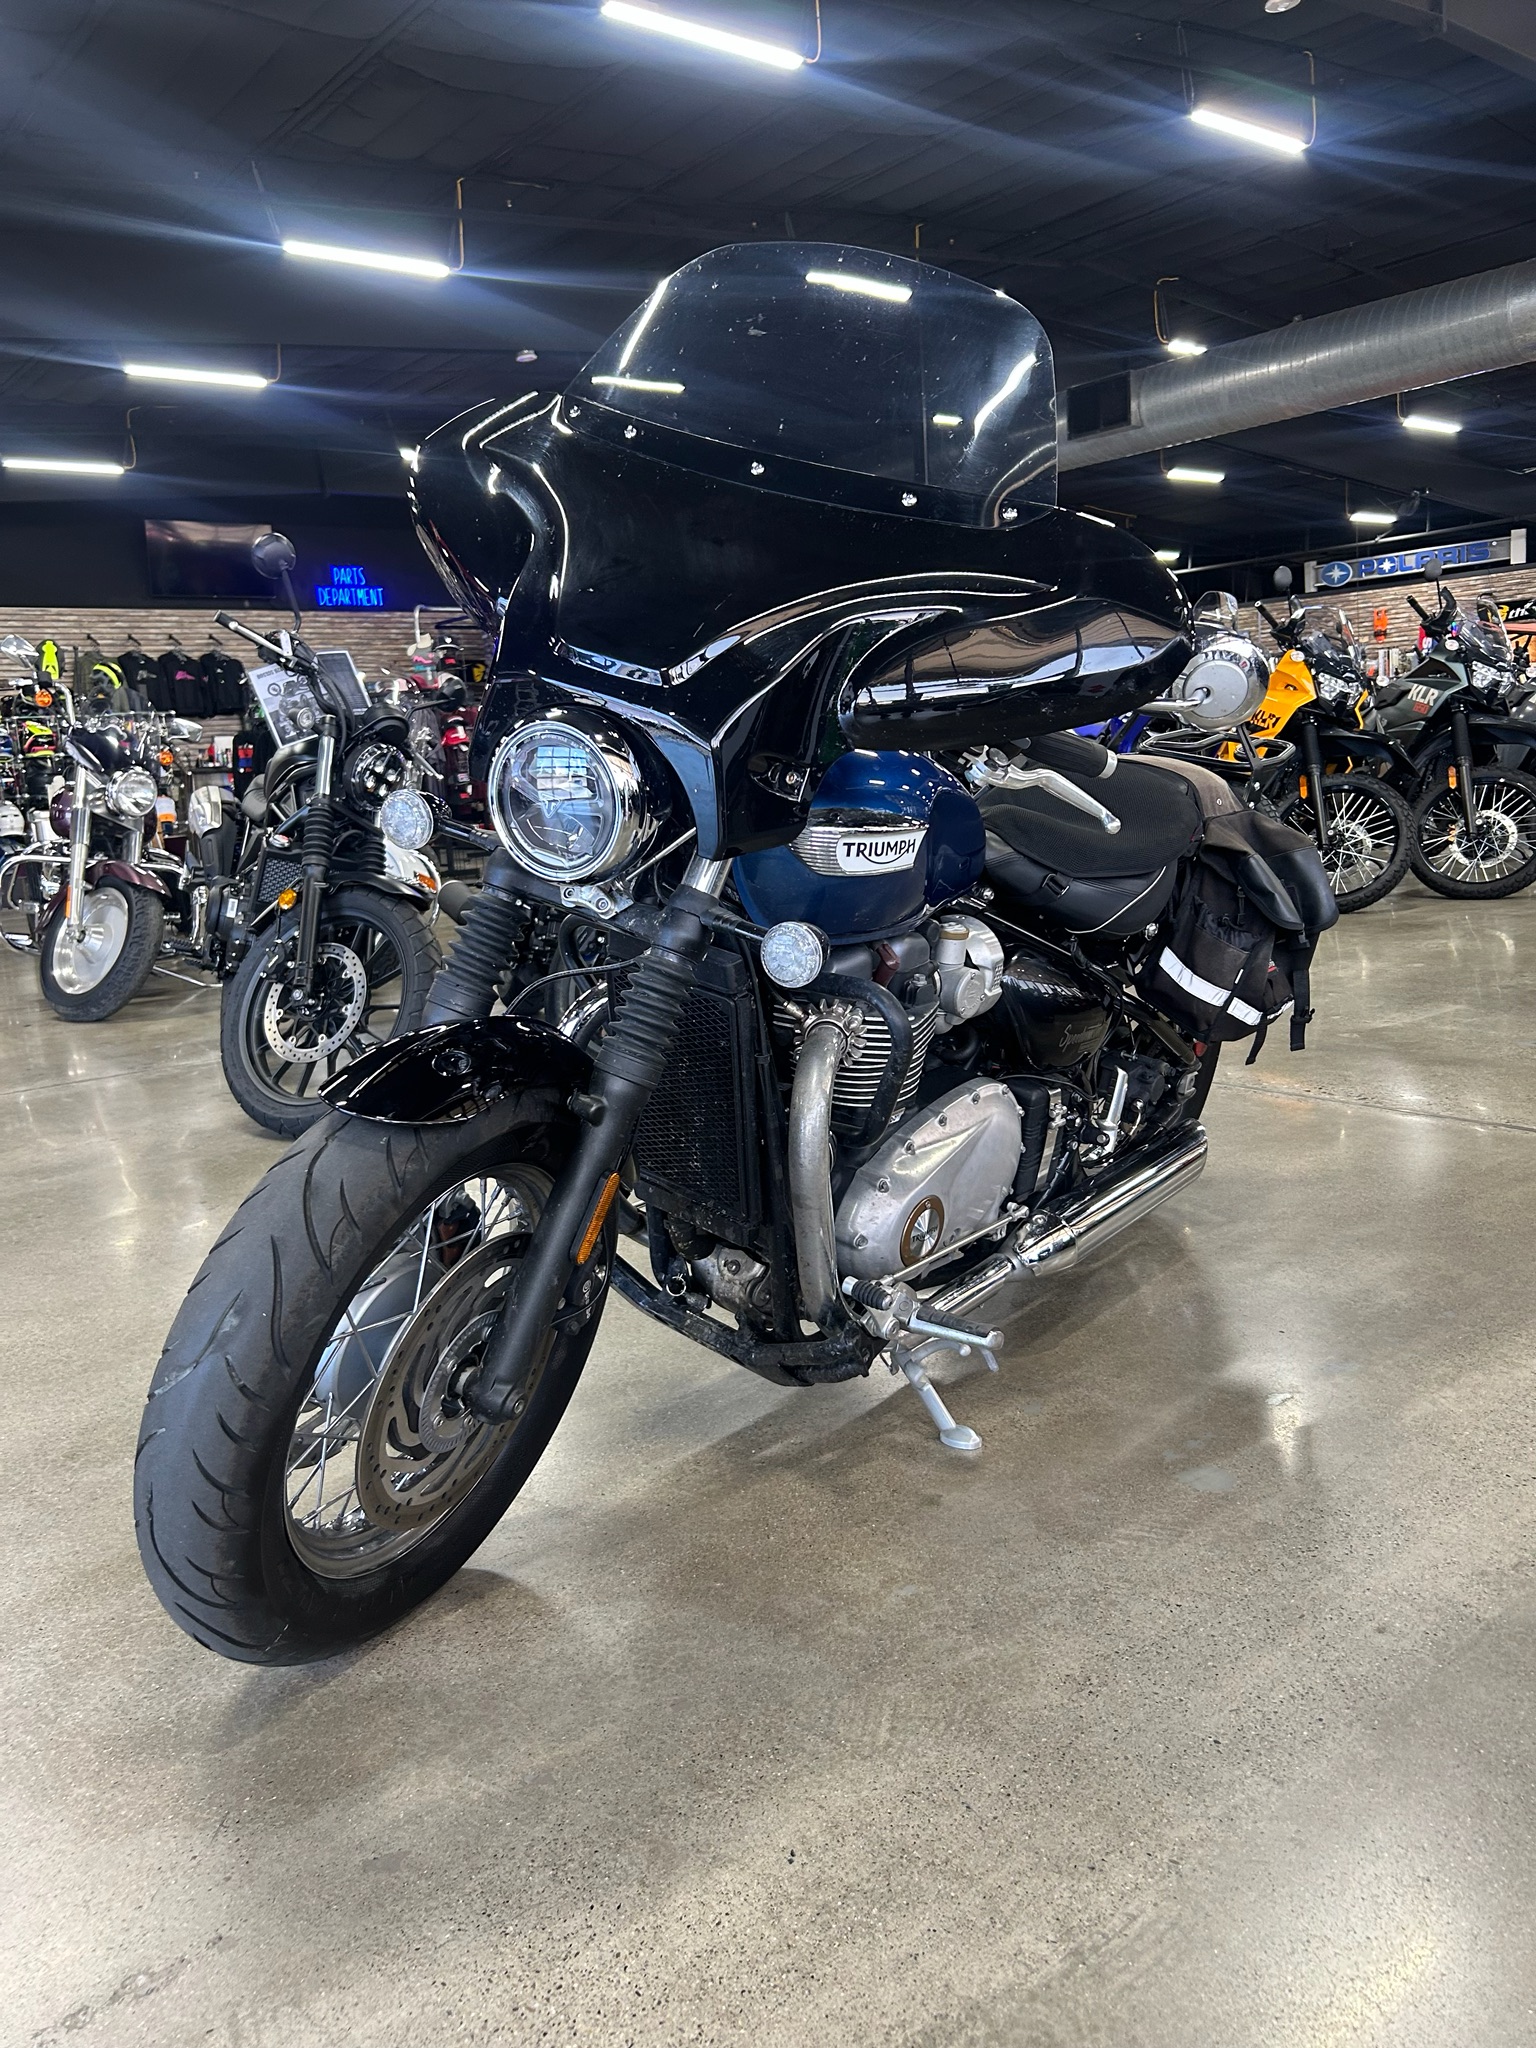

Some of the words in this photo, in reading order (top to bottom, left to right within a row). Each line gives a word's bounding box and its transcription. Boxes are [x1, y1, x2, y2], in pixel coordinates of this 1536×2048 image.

[1358, 541, 1490, 578] POLARIS
[333, 567, 366, 585] PARTS
[318, 587, 384, 606] DEPARTMENT
[1407, 683, 1439, 706] KLR
[843, 839, 916, 864] TRIUMPH
